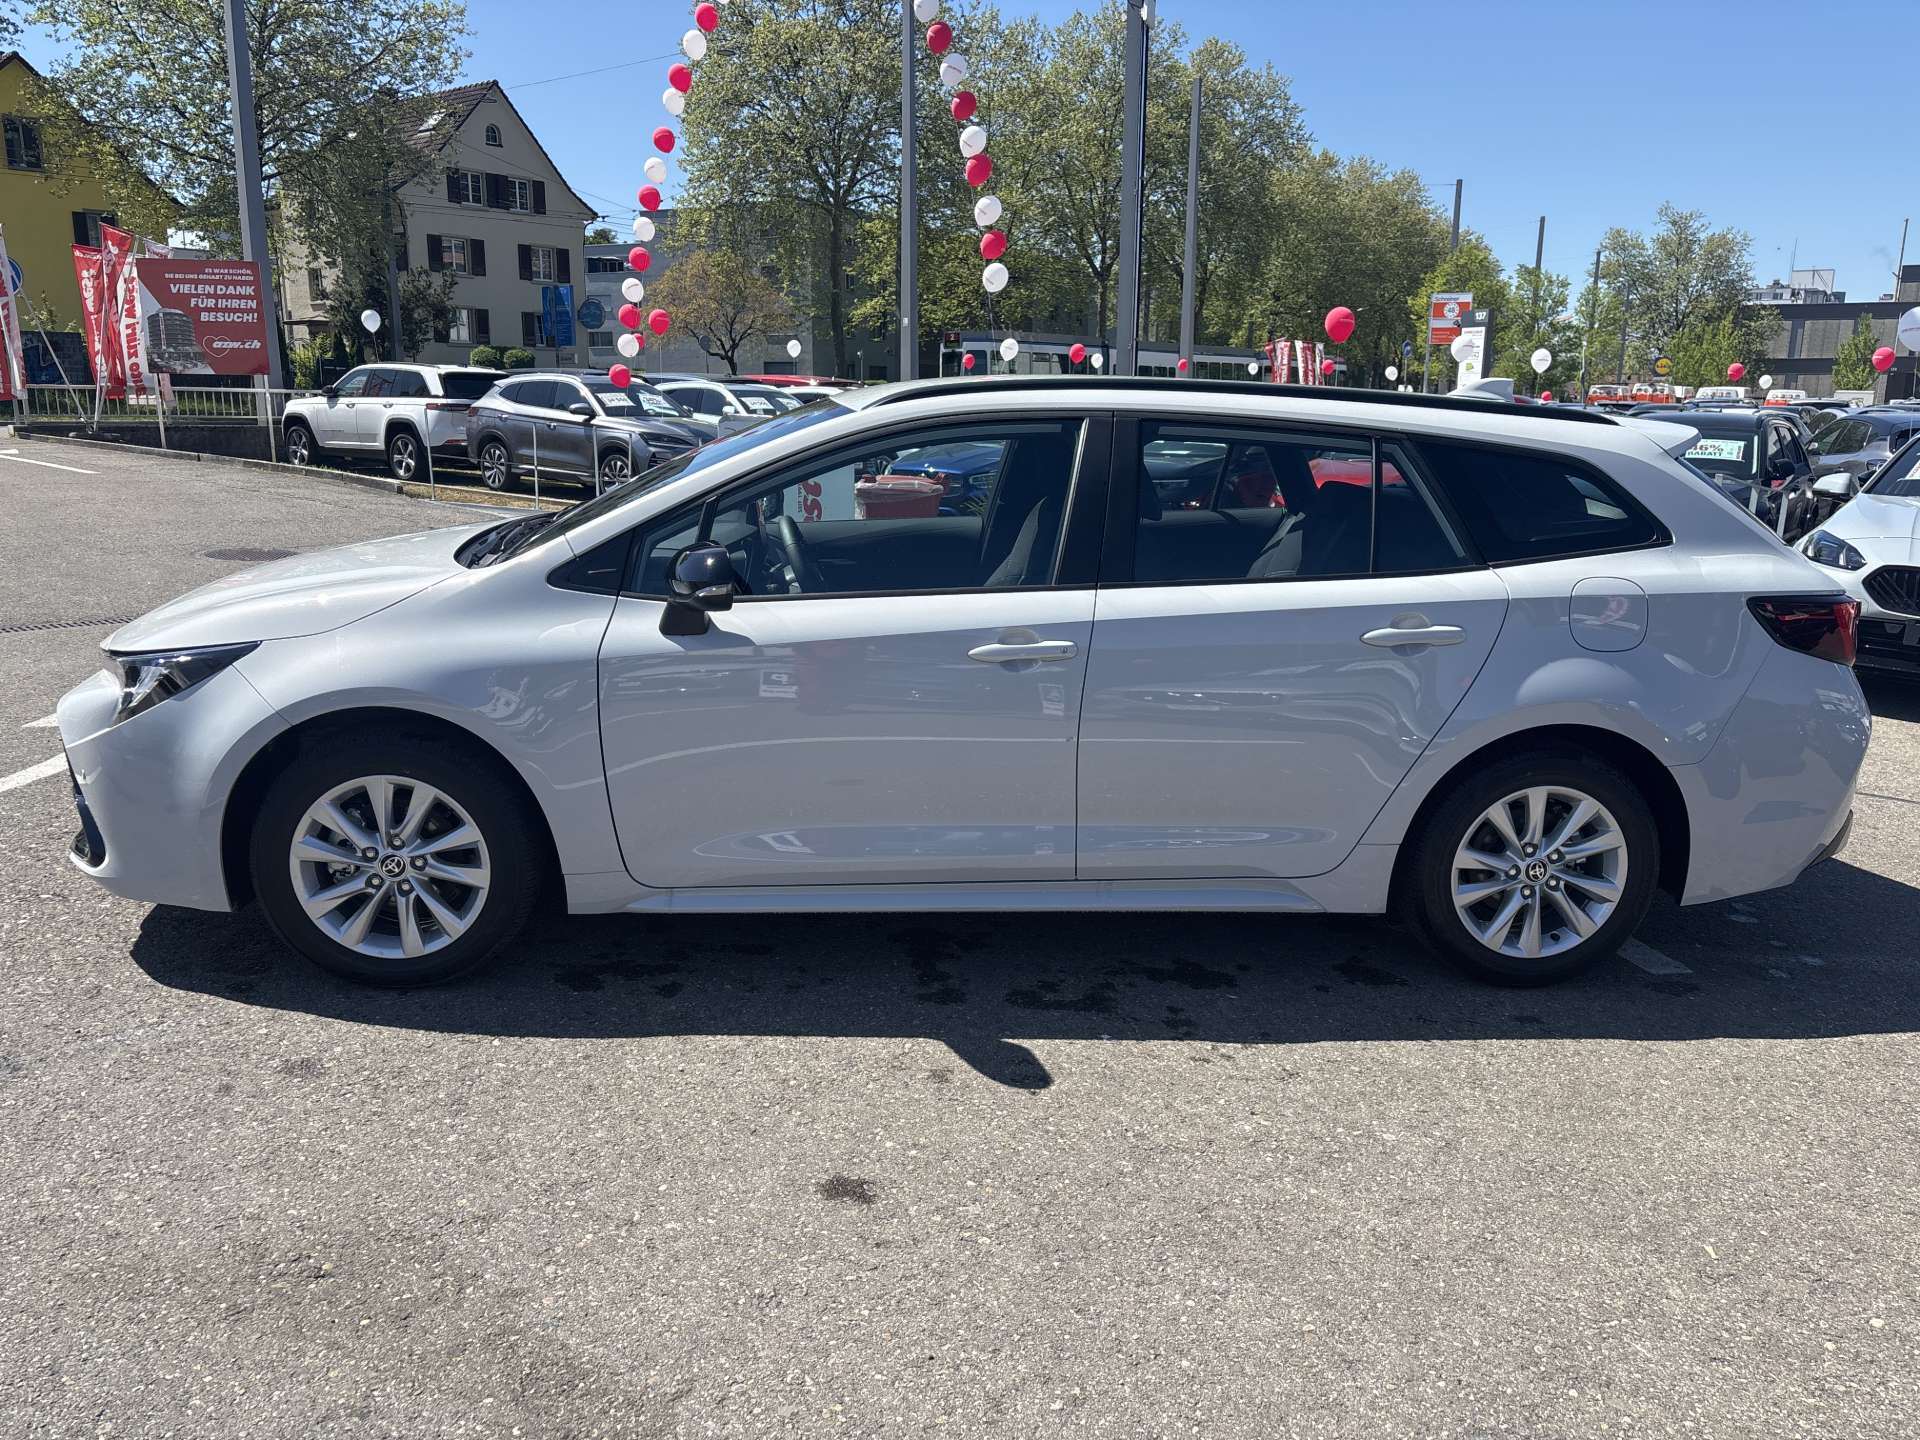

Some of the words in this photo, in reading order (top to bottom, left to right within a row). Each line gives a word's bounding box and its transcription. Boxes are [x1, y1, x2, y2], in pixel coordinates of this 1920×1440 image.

[170, 283, 215, 294] VIELEN
[216, 285, 255, 295] DANK
[190, 295, 216, 308] FÜR
[217, 299, 257, 309] IHREN
[200, 312, 258, 323] BESUCH!
